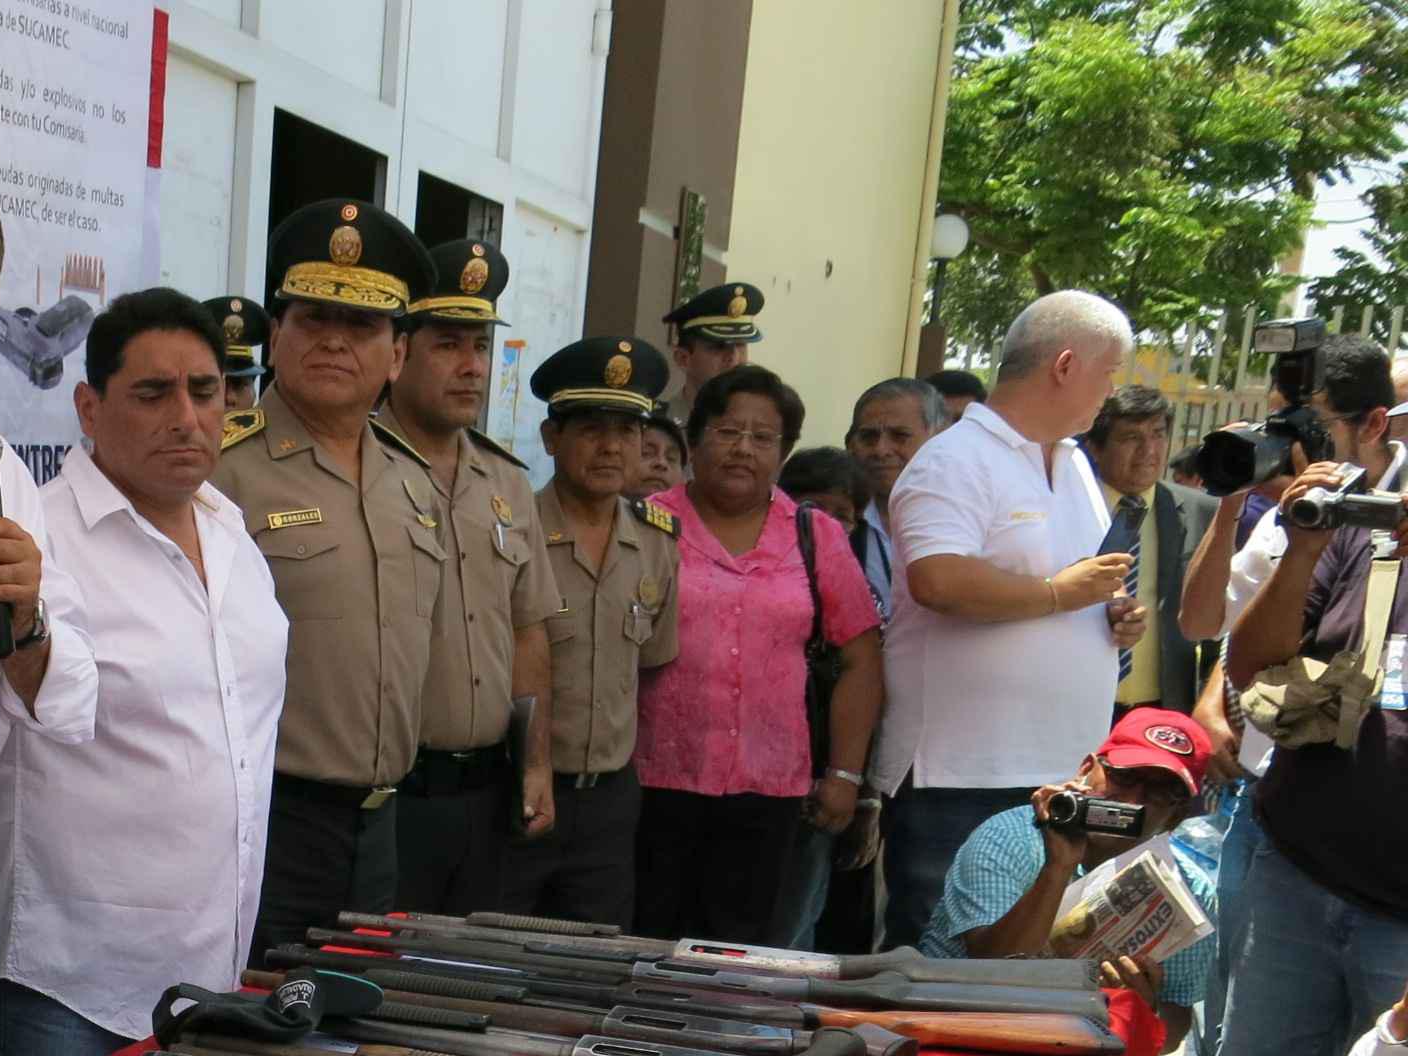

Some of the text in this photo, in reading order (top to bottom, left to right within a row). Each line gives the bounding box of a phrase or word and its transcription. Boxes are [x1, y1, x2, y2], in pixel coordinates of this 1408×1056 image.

[5, 9, 17, 30] de
[92, 13, 129, 40] nacional
[20, 79, 36, 101] y/o
[42, 87, 86, 114] explosivos
[92, 103, 105, 119] no
[111, 103, 126, 125] los
[11, 112, 30, 128] con
[31, 113, 42, 132] tu
[27, 174, 73, 197] originadas
[75, 182, 86, 200] de
[90, 187, 124, 207] multas
[41, 203, 53, 222] de
[54, 210, 68, 225] ser
